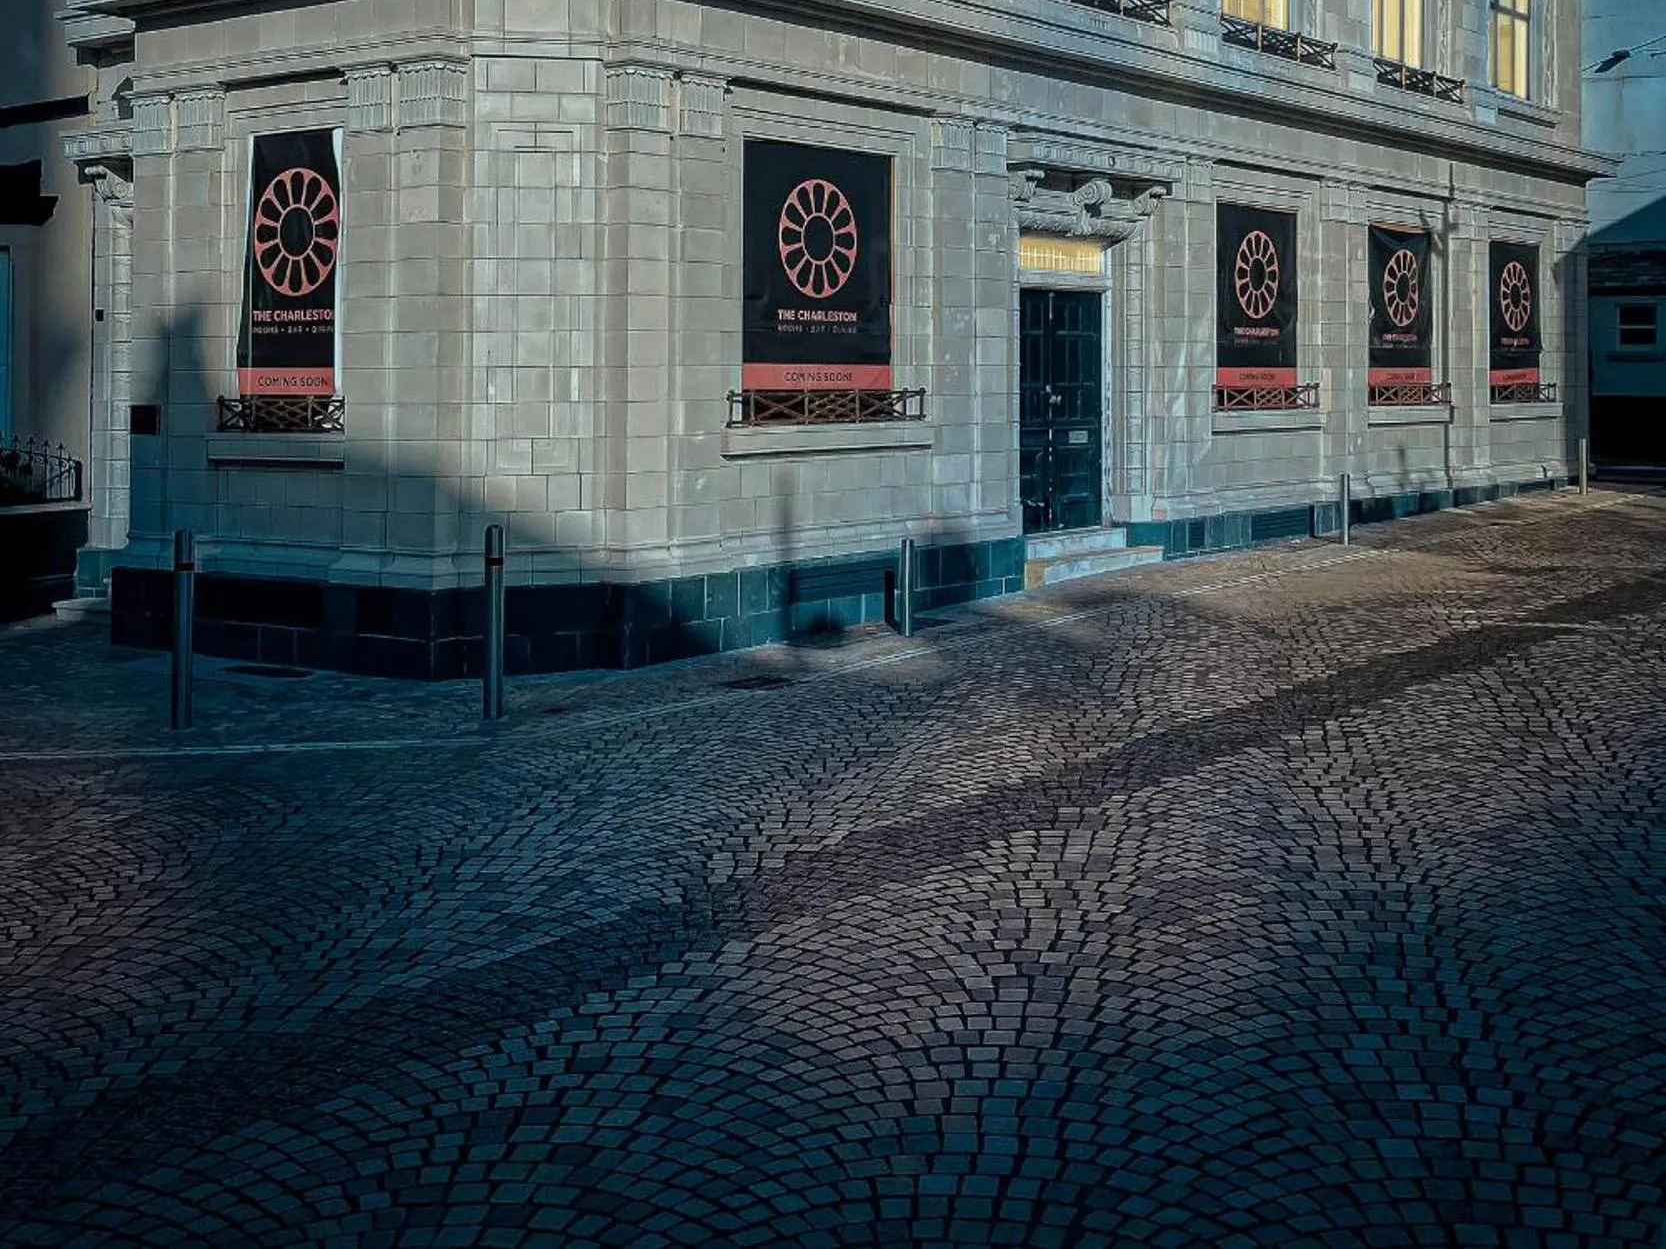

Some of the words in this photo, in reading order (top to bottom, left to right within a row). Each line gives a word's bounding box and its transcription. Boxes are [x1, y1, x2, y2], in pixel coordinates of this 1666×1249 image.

[252, 310, 272, 322] THE
[273, 308, 334, 322] CHARLESTO
[777, 309, 796, 321] THE
[797, 310, 858, 322] CHARLESTON
[257, 376, 298, 388] COMING
